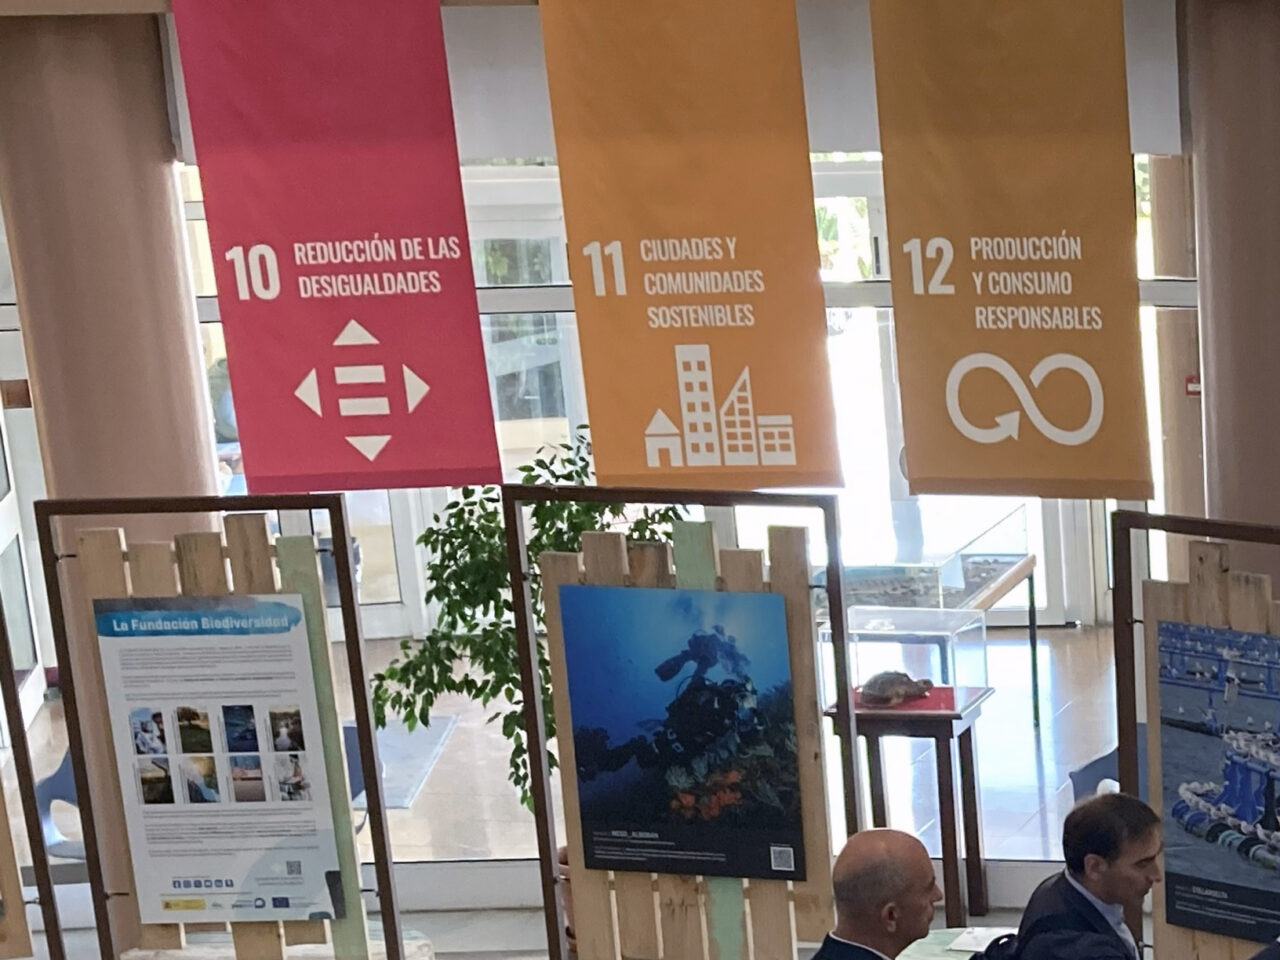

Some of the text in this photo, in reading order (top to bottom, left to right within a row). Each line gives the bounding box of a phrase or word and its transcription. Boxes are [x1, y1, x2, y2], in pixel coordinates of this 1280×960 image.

[294, 233, 461, 265] REDUCCIÓN DE LAS
[640, 237, 737, 261] CIUDADES Y
[971, 230, 1081, 260] PRODUCCIÓN
[224, 244, 281, 301] 10
[583, 241, 626, 296] 11
[903, 237, 954, 294] 12
[298, 271, 441, 298] DESIGUALDADES
[644, 270, 765, 295] COMUNIDADES
[972, 272, 1072, 294] Y CONSUMO
[648, 304, 754, 328] SOSTENIBLES
[975, 306, 1102, 329] RESPONSABLES
[113, 615, 289, 631] La Fundación Biodiversidad
